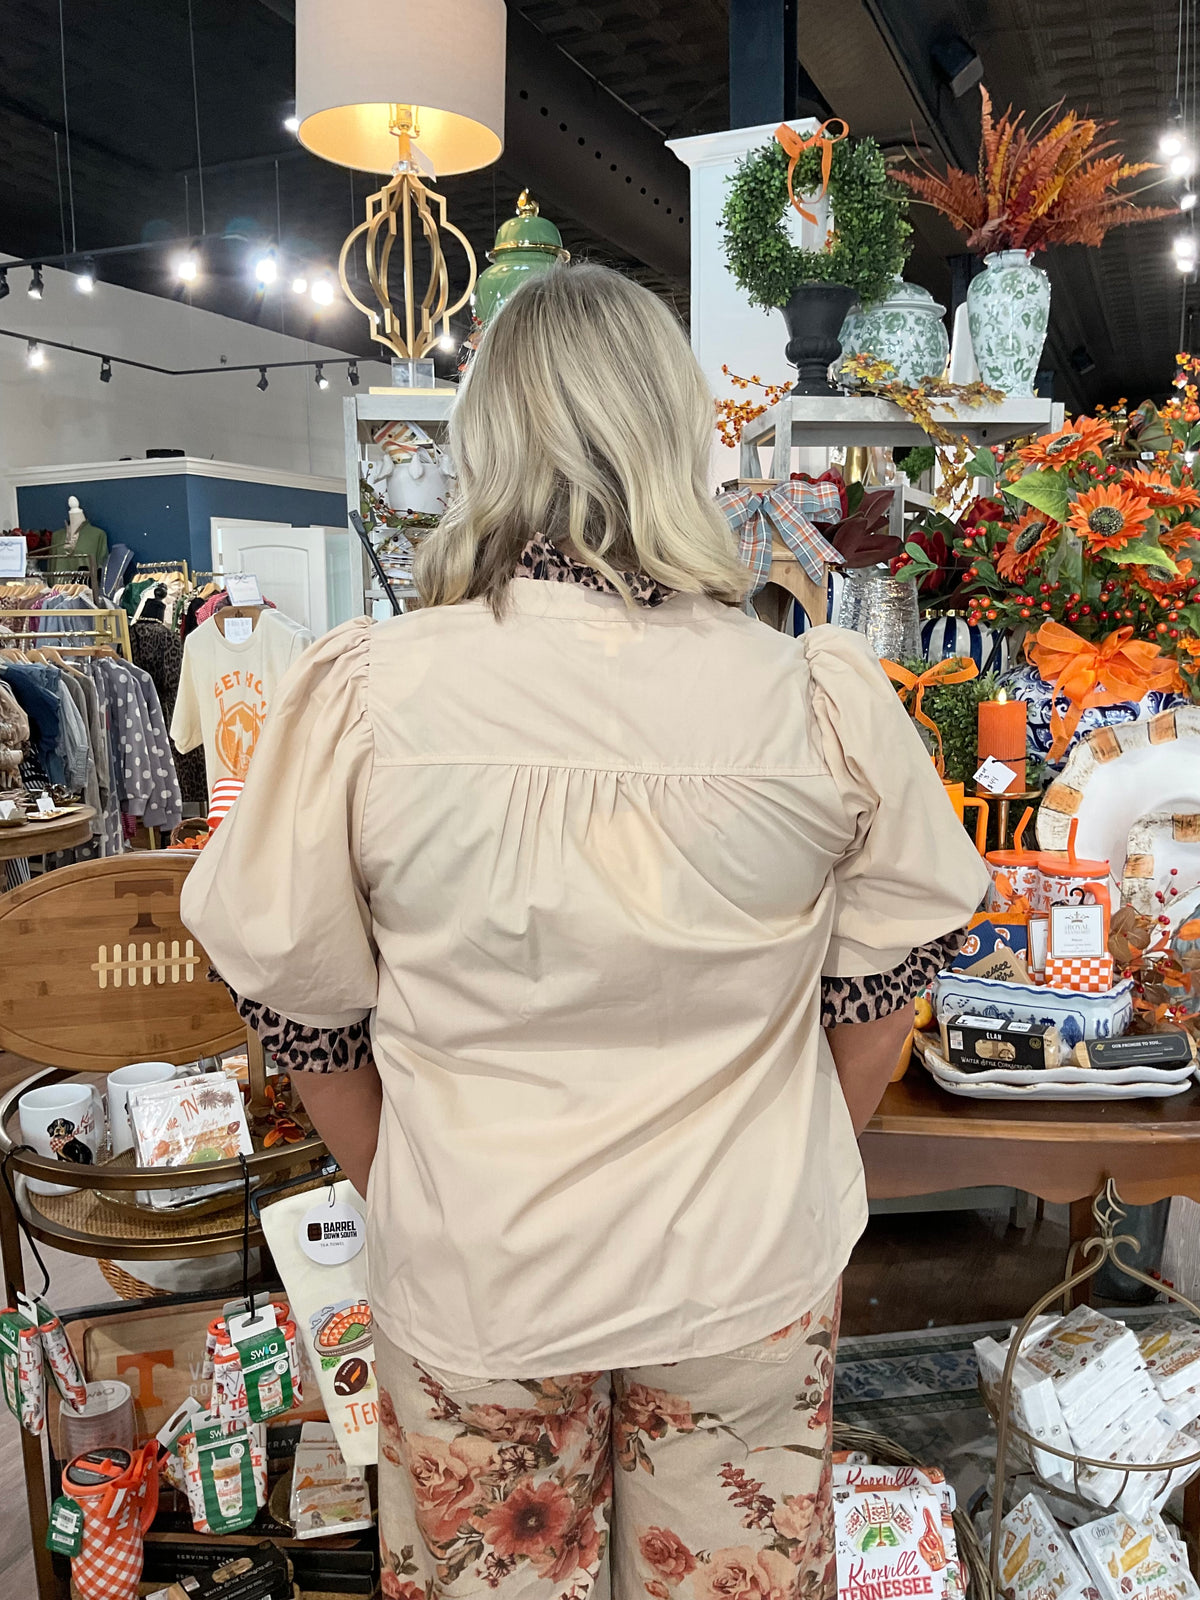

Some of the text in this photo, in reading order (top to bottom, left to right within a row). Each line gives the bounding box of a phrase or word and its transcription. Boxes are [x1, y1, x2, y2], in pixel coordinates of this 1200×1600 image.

[323, 1220, 356, 1232] BARREL
[323, 1231, 358, 1240] DOWN SOUTH
[267, 1438, 294, 1449] TRAY
[848, 1550, 920, 1588] Knoxville
[839, 1576, 934, 1600] TENNESSEE
